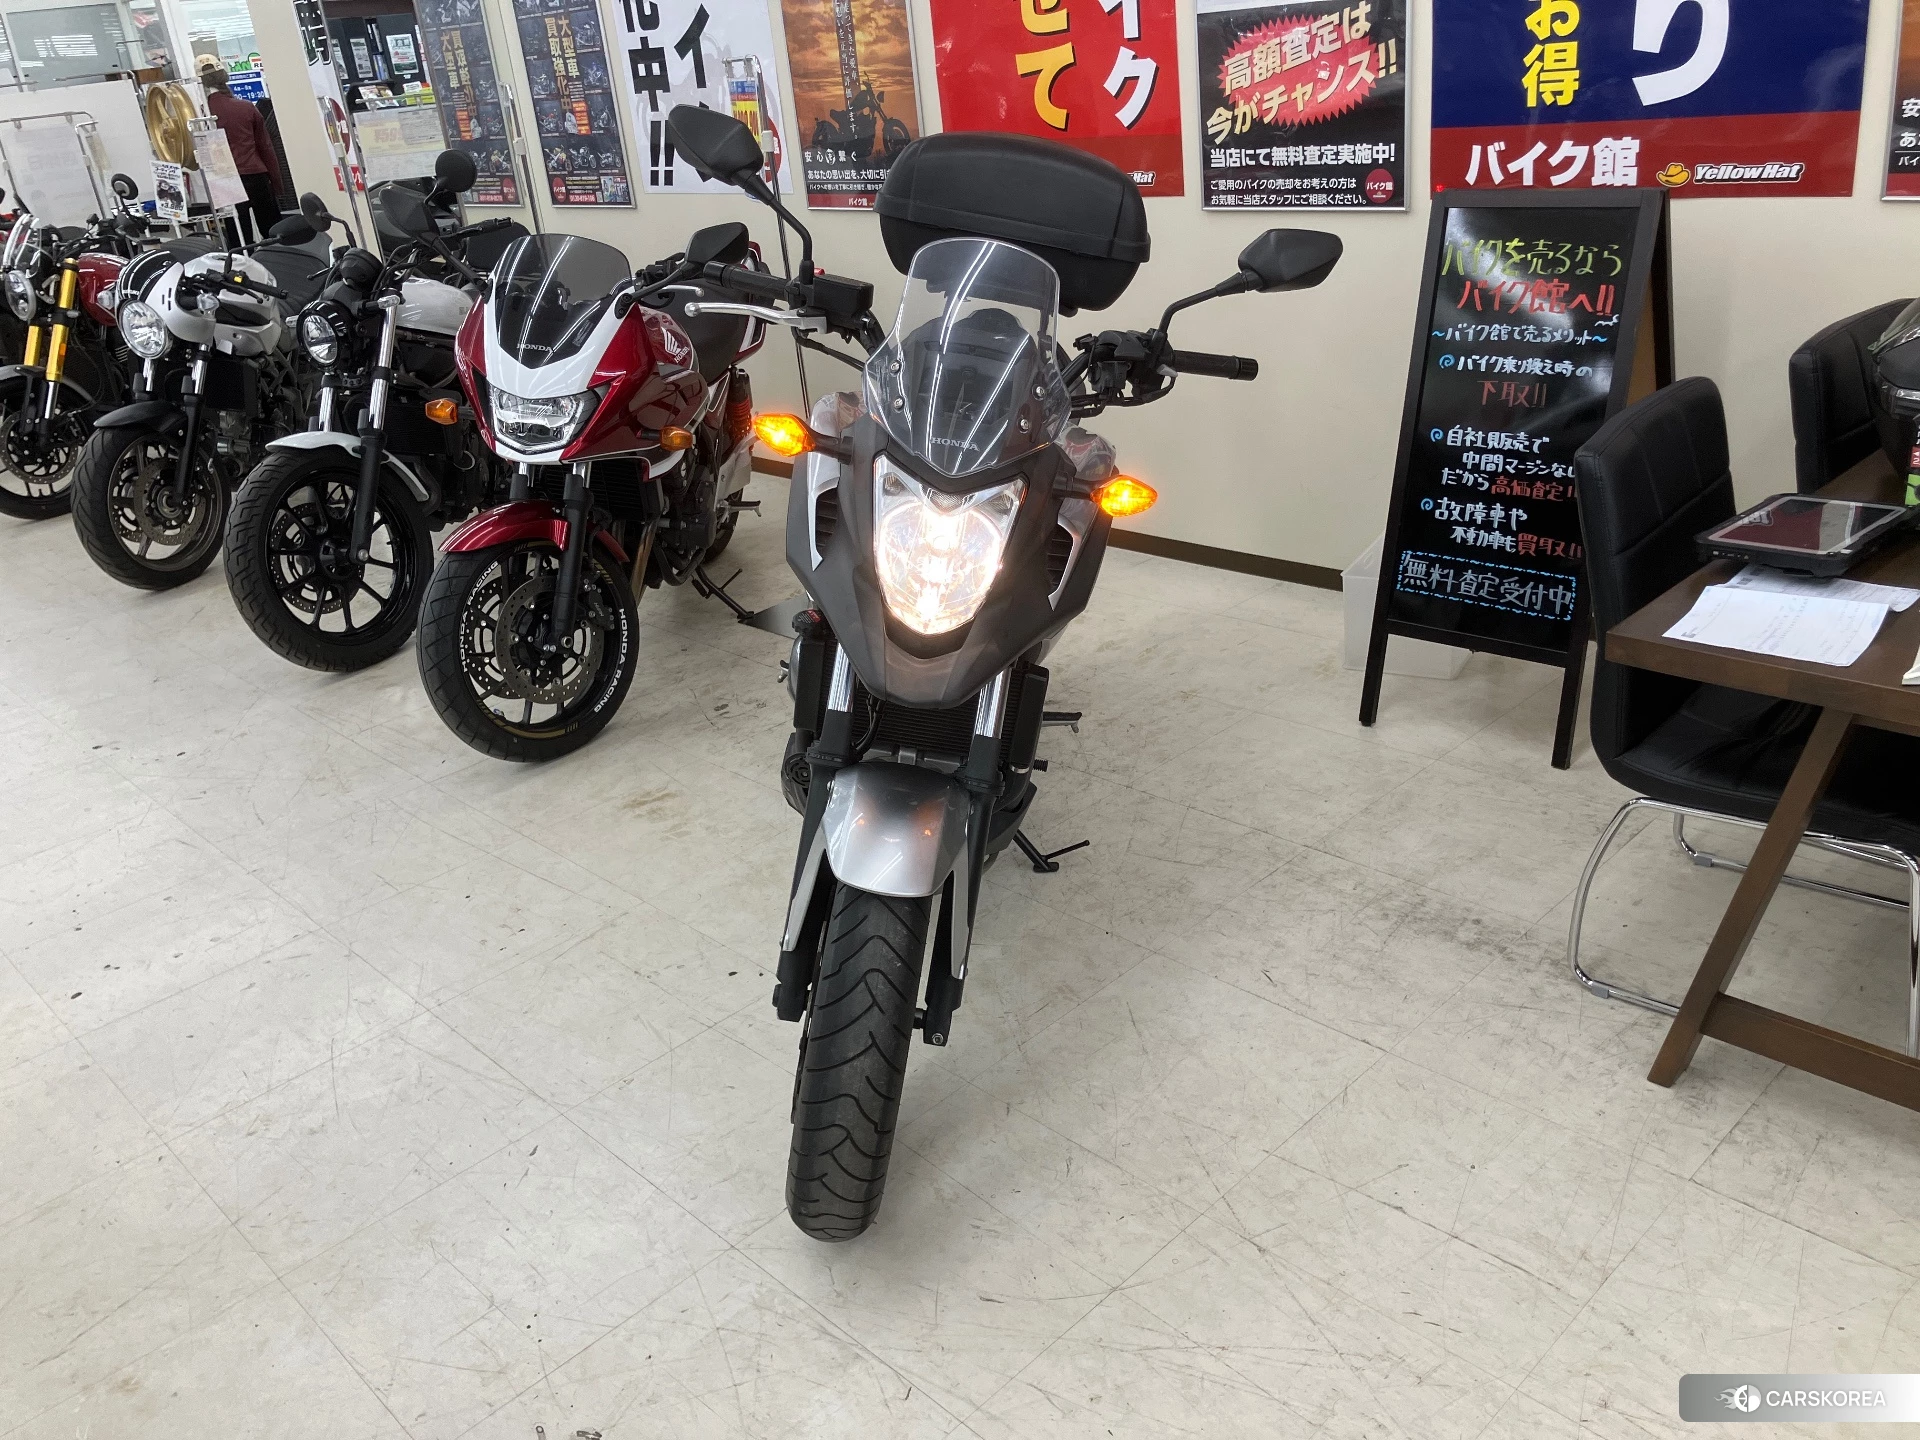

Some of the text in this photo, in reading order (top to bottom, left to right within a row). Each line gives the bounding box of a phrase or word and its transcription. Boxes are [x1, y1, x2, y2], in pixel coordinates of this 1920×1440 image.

[558, 16, 580, 78] 大型車
[1214, 1, 1372, 96] 高額査定は
[1206, 38, 1398, 145] 今がチャンス!!
[1210, 143, 1395, 168] 当店にて無料査定実施中!
[1899, 132, 1920, 147] あ
[1465, 137, 1640, 187] バイク館
[1210, 177, 1357, 191] ご愛用のバイクの売却をお考えの方は
[1211, 193, 1367, 206] お気軽に当店スタッフにご相談ください。
[1441, 237, 1622, 277] バイクを売るなら
[1456, 278, 1616, 317] バイク館へ!!
[516, 343, 554, 353] HONDA
[1457, 355, 1593, 378] バイク乗り換え時の
[930, 437, 980, 452] HONDA
[1446, 425, 1550, 453] 自社販売で
[1434, 497, 1528, 531] 故障車や
[1402, 554, 1572, 614] 無料査定受付中
[593, 608, 628, 713] HONDA RACING
